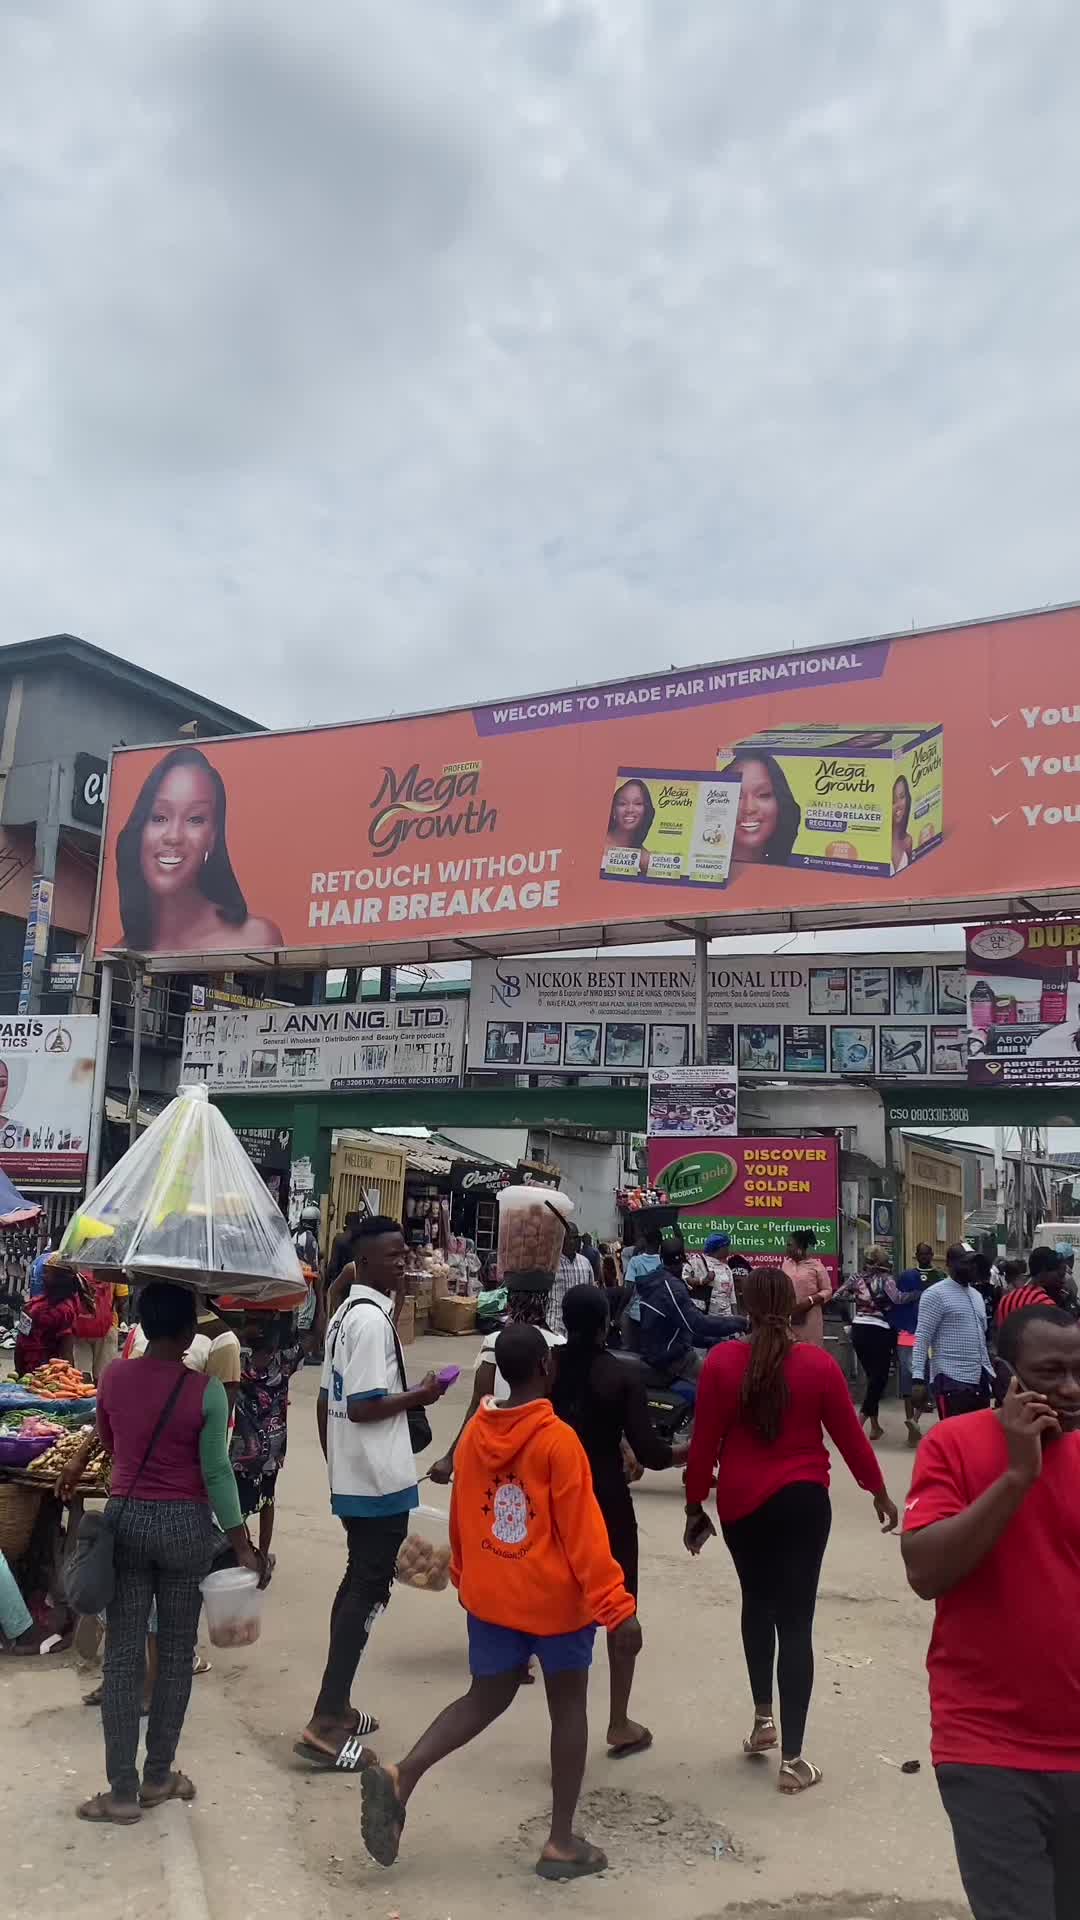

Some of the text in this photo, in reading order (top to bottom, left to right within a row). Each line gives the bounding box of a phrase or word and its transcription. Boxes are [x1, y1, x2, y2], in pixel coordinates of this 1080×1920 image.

[492, 653, 862, 724] WELCOME TO TRADE FAIR INTERNATIONAL
[1020, 705, 1080, 729] You
[443, 761, 480, 773] PROFECTIV
[816, 760, 866, 780] Mega
[911, 757, 942, 787] Growth
[1021, 755, 1080, 777] You
[369, 763, 480, 810] Mega
[659, 785, 689, 799] Mega
[815, 775, 875, 795] Growth
[657, 796, 692, 808] Growth
[843, 812, 881, 821] RELAXER
[1021, 803, 1080, 826] You
[368, 800, 498, 857] Growth
[809, 820, 843, 828] REGULAR
[610, 858, 635, 866] RELAXER
[803, 857, 809, 865] 2
[311, 849, 562, 894] RETOUCH WITHOUT
[308, 880, 561, 928] HAIR BREAKAGE
[524, 970, 807, 989] NICKOK BEST INTERNIONAL LTD.
[260, 1008, 449, 1033] J. ANYI NIG. LTD.
[1, 1038, 28, 1047] TICS
[325, 1034, 360, 1043] Distribution
[376, 1033, 399, 1042] Beauty
[400, 1032, 415, 1040] Care
[416, 1032, 445, 1041] products
[743, 1149, 827, 1161] DISCOVER
[744, 1164, 789, 1176] YOUR
[670, 1186, 703, 1200] PRODUCTS
[743, 1180, 810, 1192] GOLDEN
[744, 1195, 783, 1207] SKIN
[710, 1220, 735, 1235] Baby
[737, 1220, 760, 1231] Care
[768, 1220, 831, 1233] Perfumeries
[688, 1234, 707, 1244] Car
